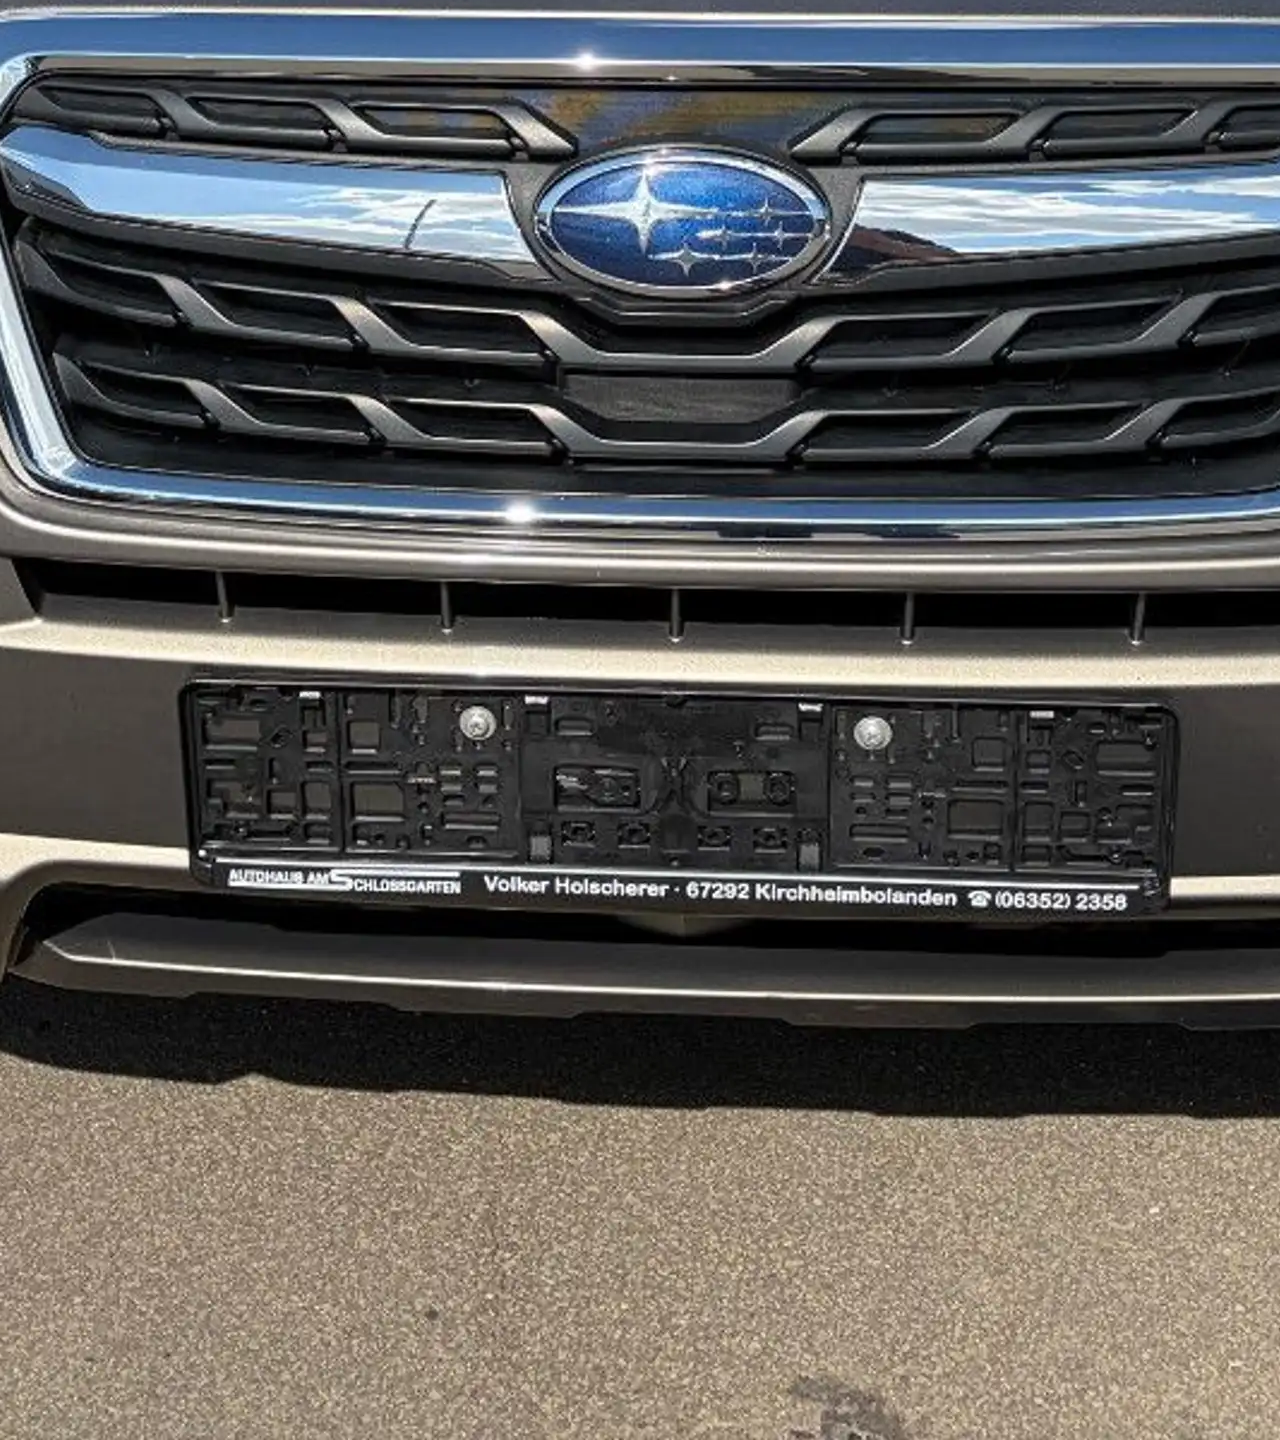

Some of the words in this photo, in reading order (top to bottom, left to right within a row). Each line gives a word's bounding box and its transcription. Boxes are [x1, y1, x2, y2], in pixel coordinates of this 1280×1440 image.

[228, 868, 304, 885] AUTOHAUS
[307, 871, 330, 886] AM
[331, 869, 462, 894] SCHLOSSGARTEN
[483, 875, 550, 893] Volker
[555, 877, 670, 898] Holscherer
[685, 881, 750, 900] 67292
[755, 883, 959, 906] Kirchheimbolanden
[994, 890, 1071, 909] (06352)
[1075, 892, 1128, 911] 2358
